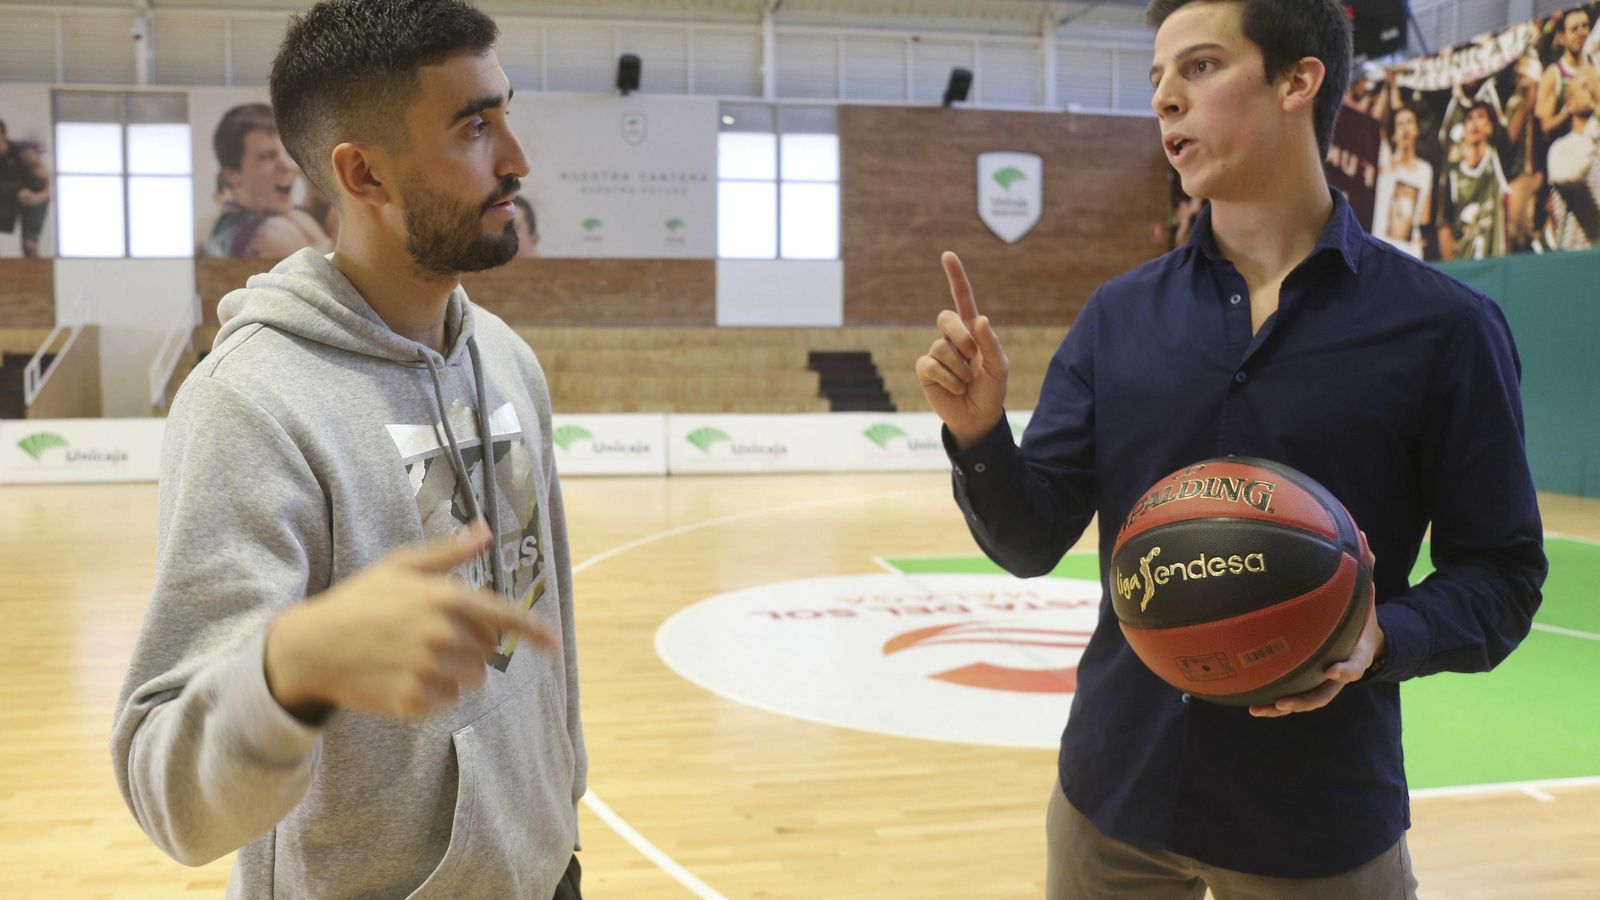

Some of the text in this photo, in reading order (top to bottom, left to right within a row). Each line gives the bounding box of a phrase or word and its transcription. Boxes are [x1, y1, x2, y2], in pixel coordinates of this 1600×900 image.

[65, 447, 129, 465] Unicaja
[592, 440, 650, 456] Unicaja
[731, 441, 788, 455] Unicaja
[1116, 552, 1266, 600] liga endesa
[750, 609, 859, 622] SOL
